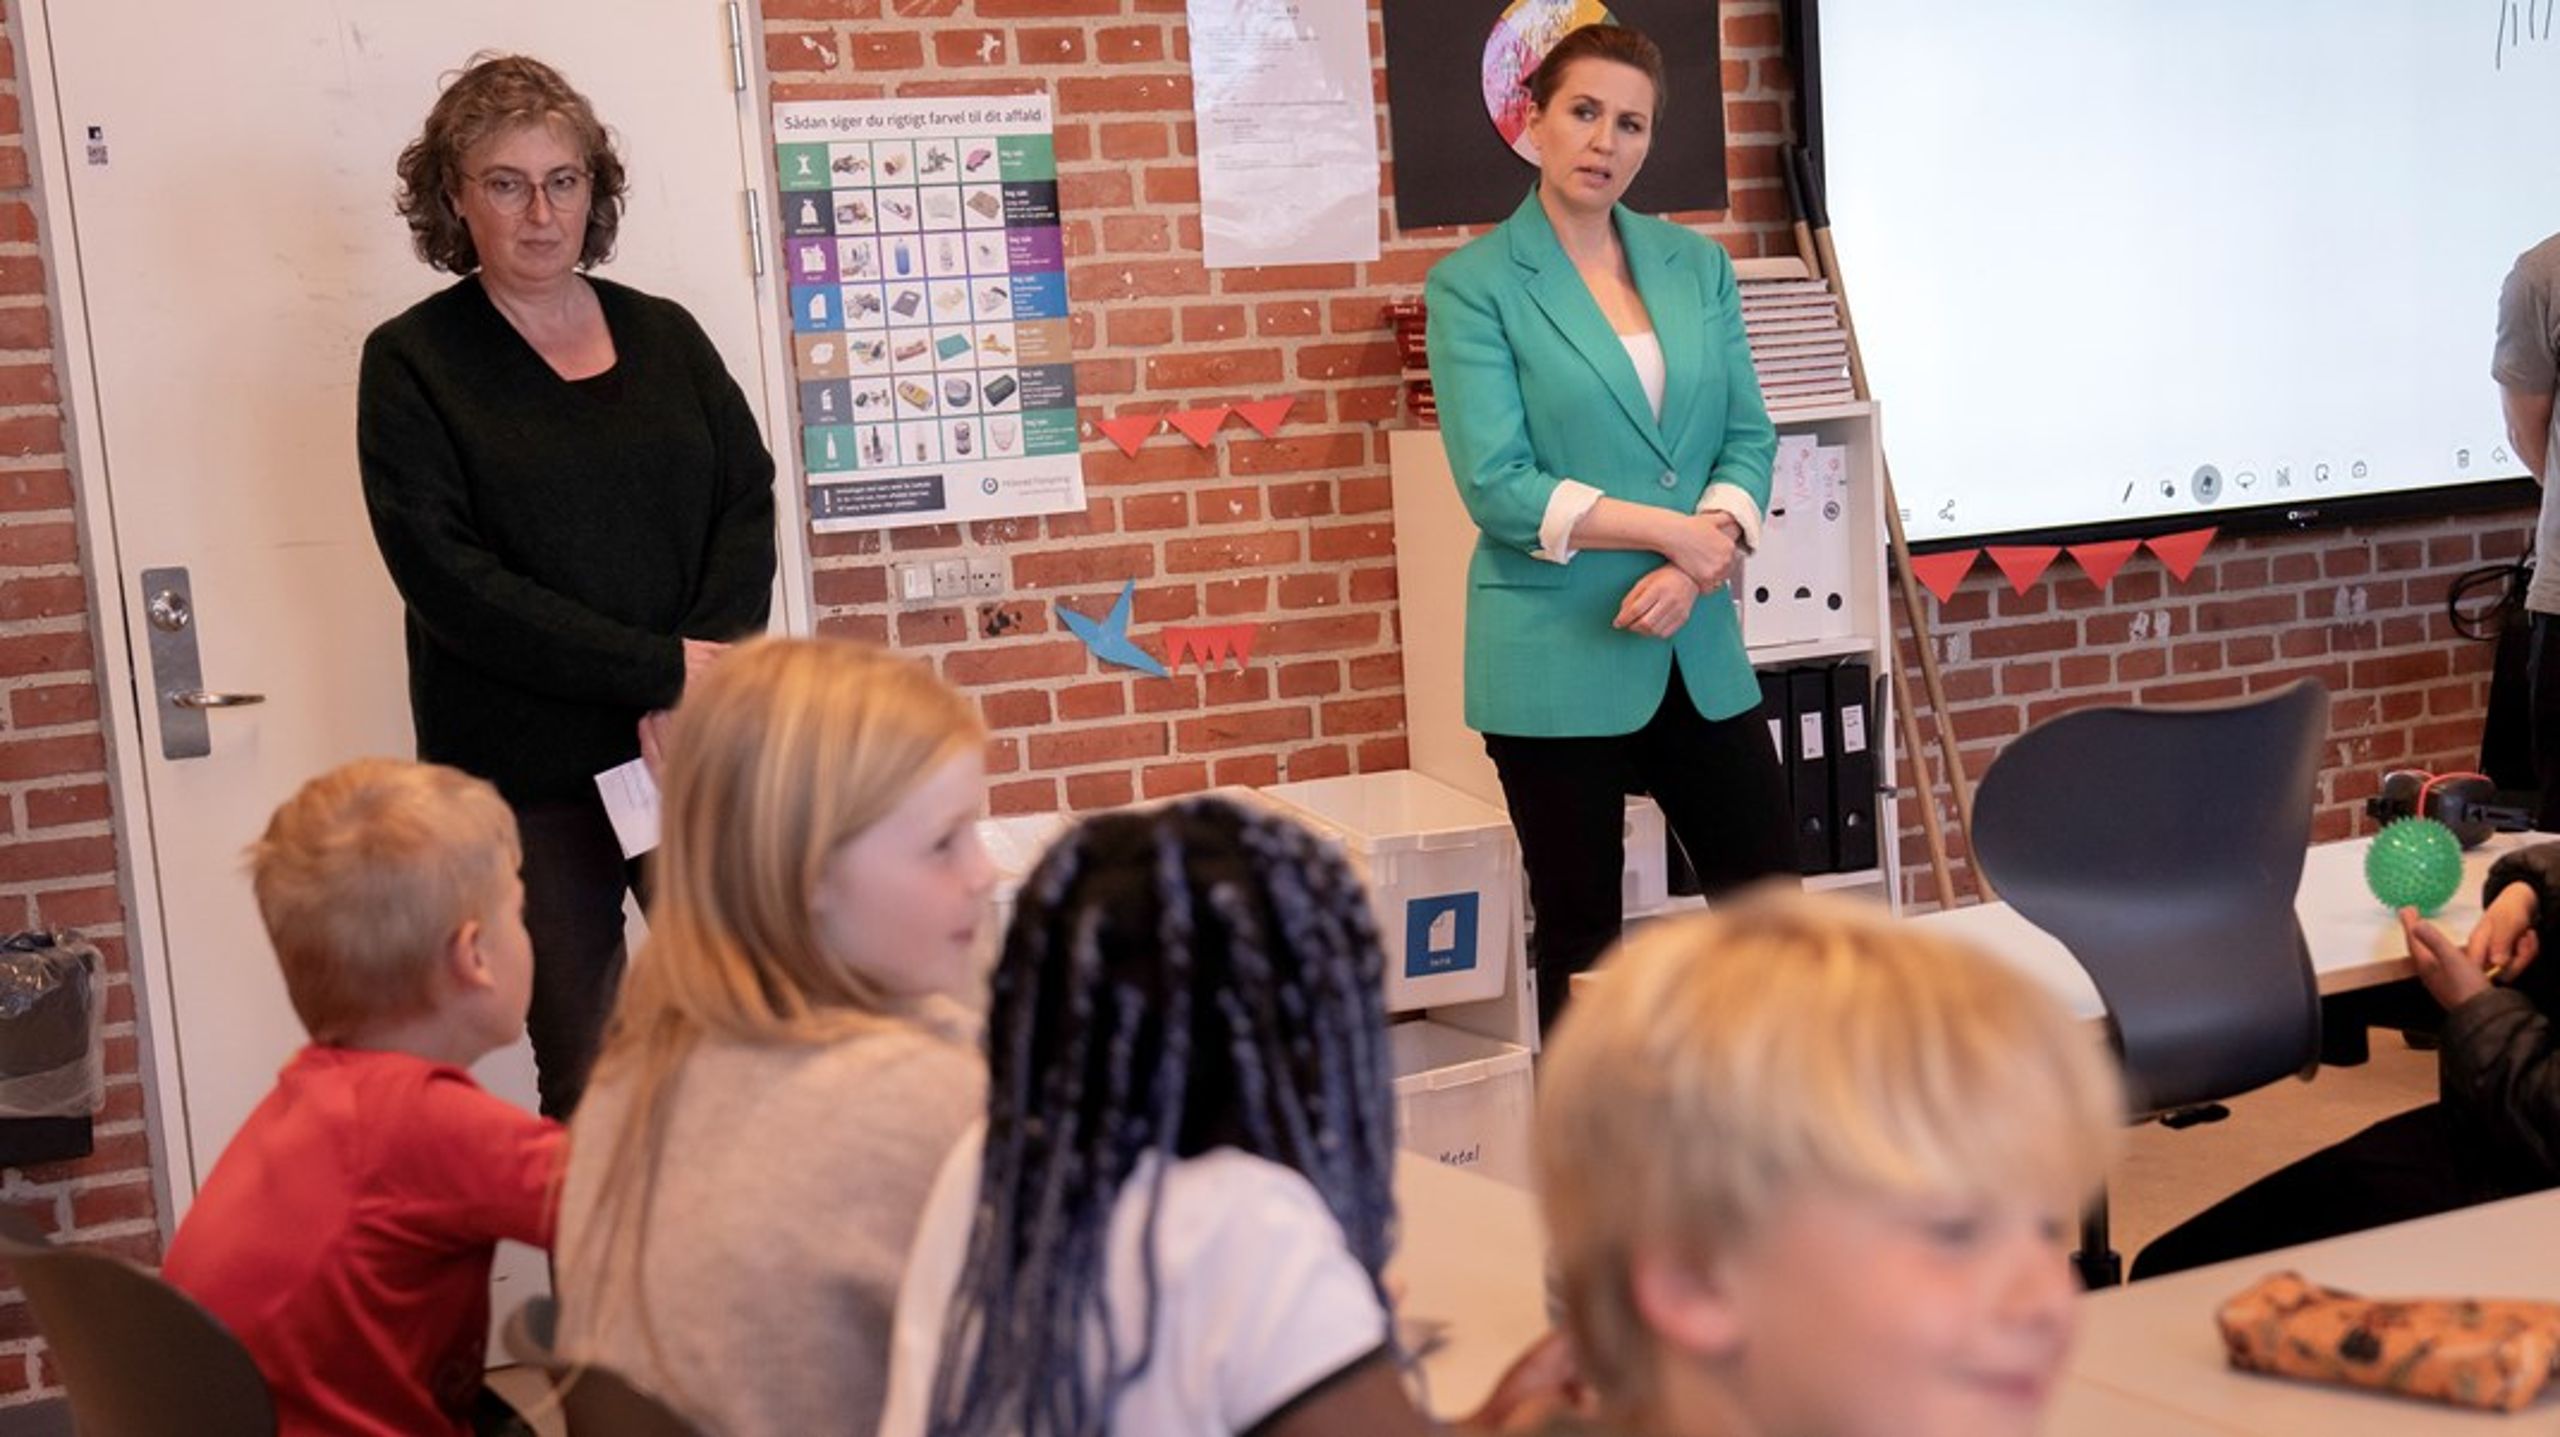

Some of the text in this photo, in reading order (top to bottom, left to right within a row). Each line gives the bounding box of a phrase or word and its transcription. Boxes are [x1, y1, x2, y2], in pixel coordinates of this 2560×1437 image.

[784, 108, 1041, 132] Sådan siger du rigtigt farvel til dit affald
